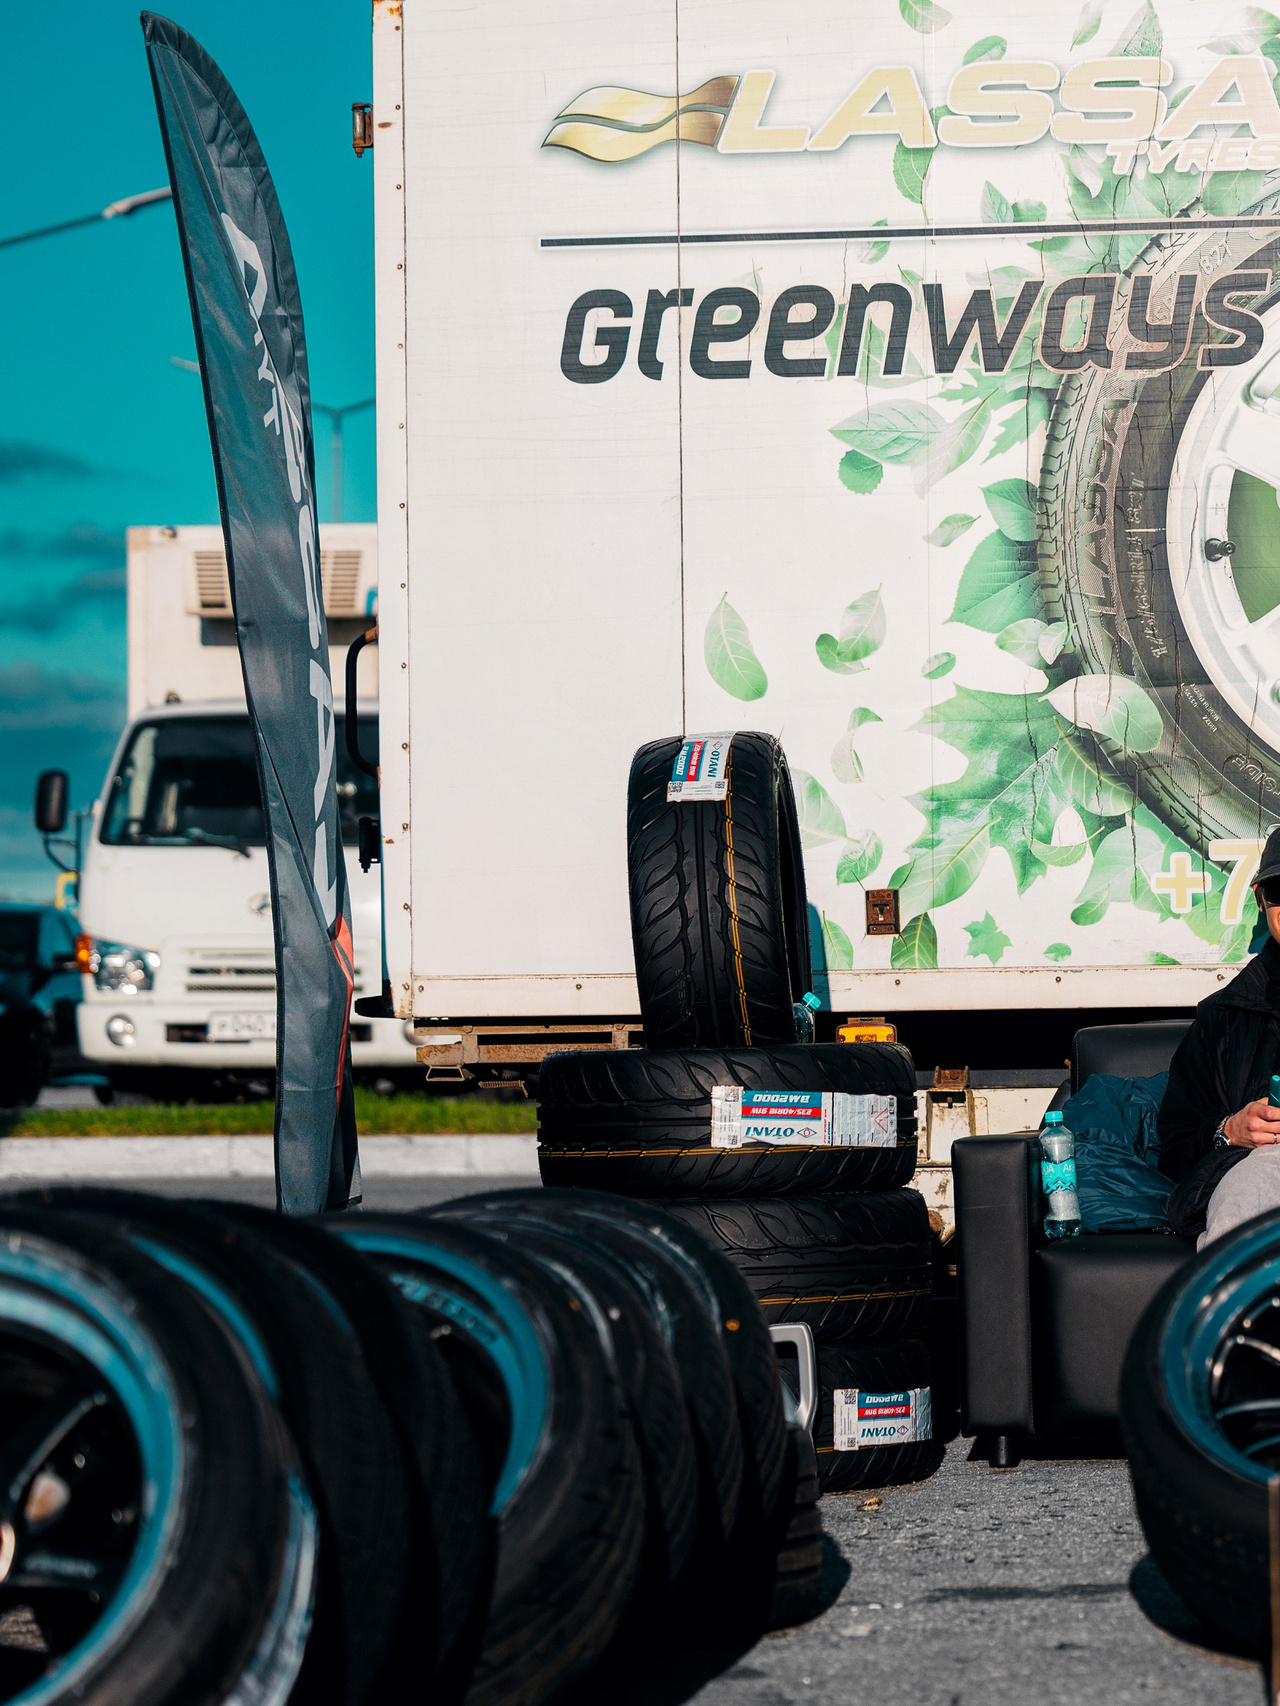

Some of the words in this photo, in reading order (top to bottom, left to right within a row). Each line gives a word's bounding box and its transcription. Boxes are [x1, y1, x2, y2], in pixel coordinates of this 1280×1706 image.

[559, 268, 1273, 385] Greenways
[707, 750, 721, 778] OTANI
[752, 1092, 811, 1104] BM2000
[750, 1106, 768, 1116] 91W
[768, 1106, 813, 1116] 235/40R18
[745, 1126, 795, 1139] OTANI
[861, 1426, 897, 1439] OTANI
